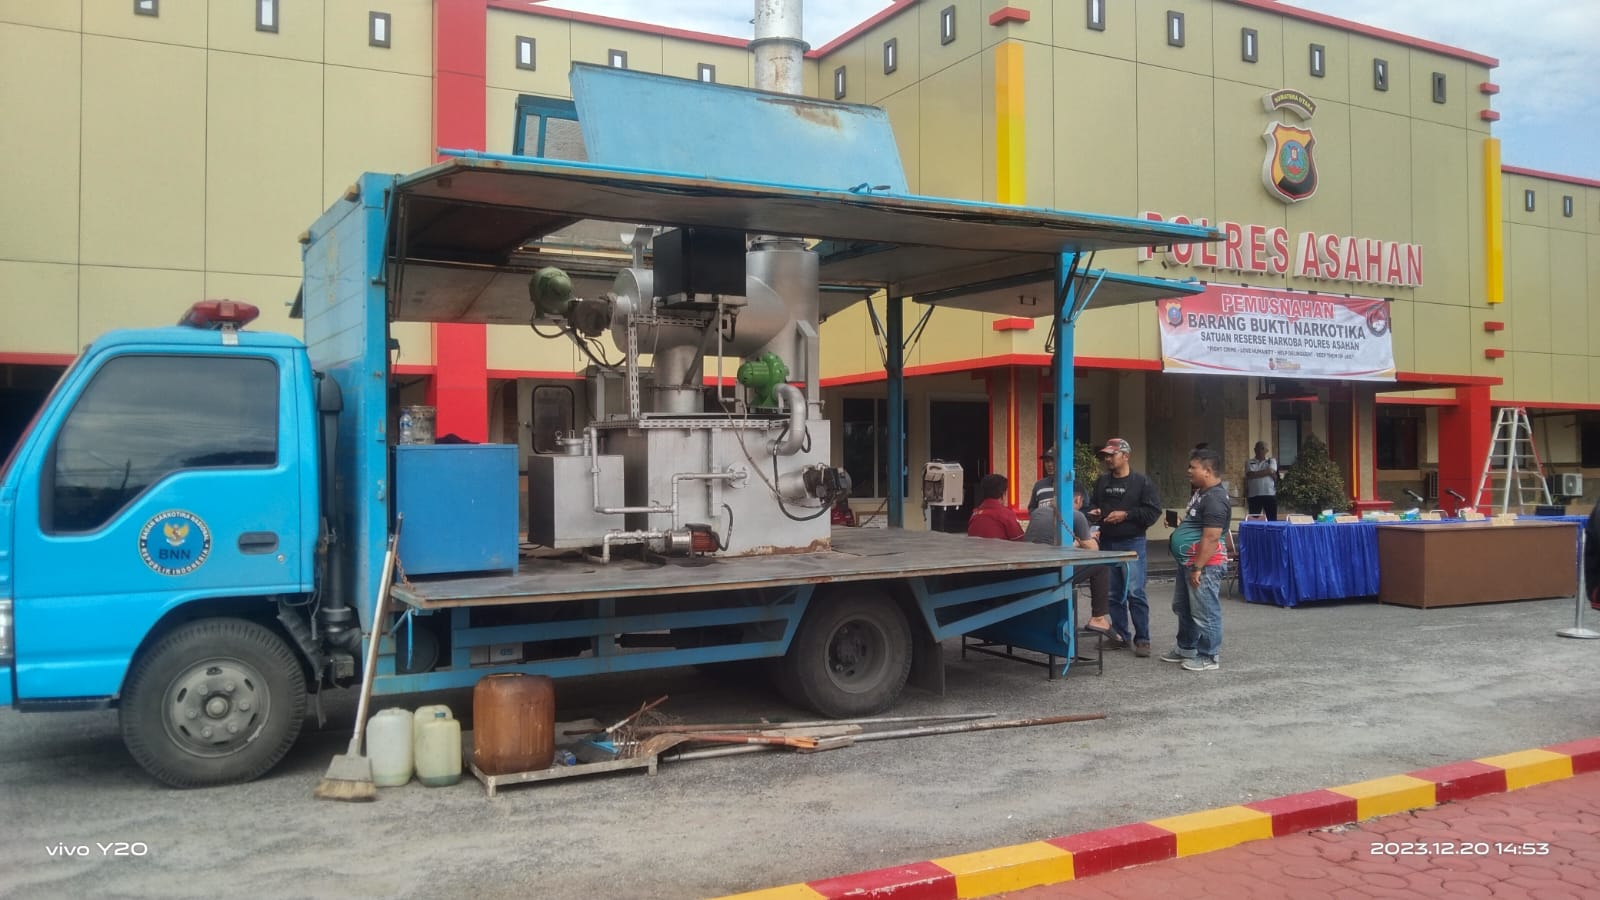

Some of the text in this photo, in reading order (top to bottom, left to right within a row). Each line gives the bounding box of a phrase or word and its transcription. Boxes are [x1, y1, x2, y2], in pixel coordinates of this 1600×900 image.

[1300, 231, 1423, 287] ASAHAN
[1222, 294, 1335, 319] PEMUSNAHAN
[1187, 313, 1366, 340] BARANG BUKTI NARKOTIKA
[1200, 331, 1360, 351] SATUAN RESERSE NARKOBA POLRES ASAHAN
[154, 511, 190, 522] NARKOTIKA
[158, 549, 191, 560] BNN
[172, 549, 209, 575] INDONESIA
